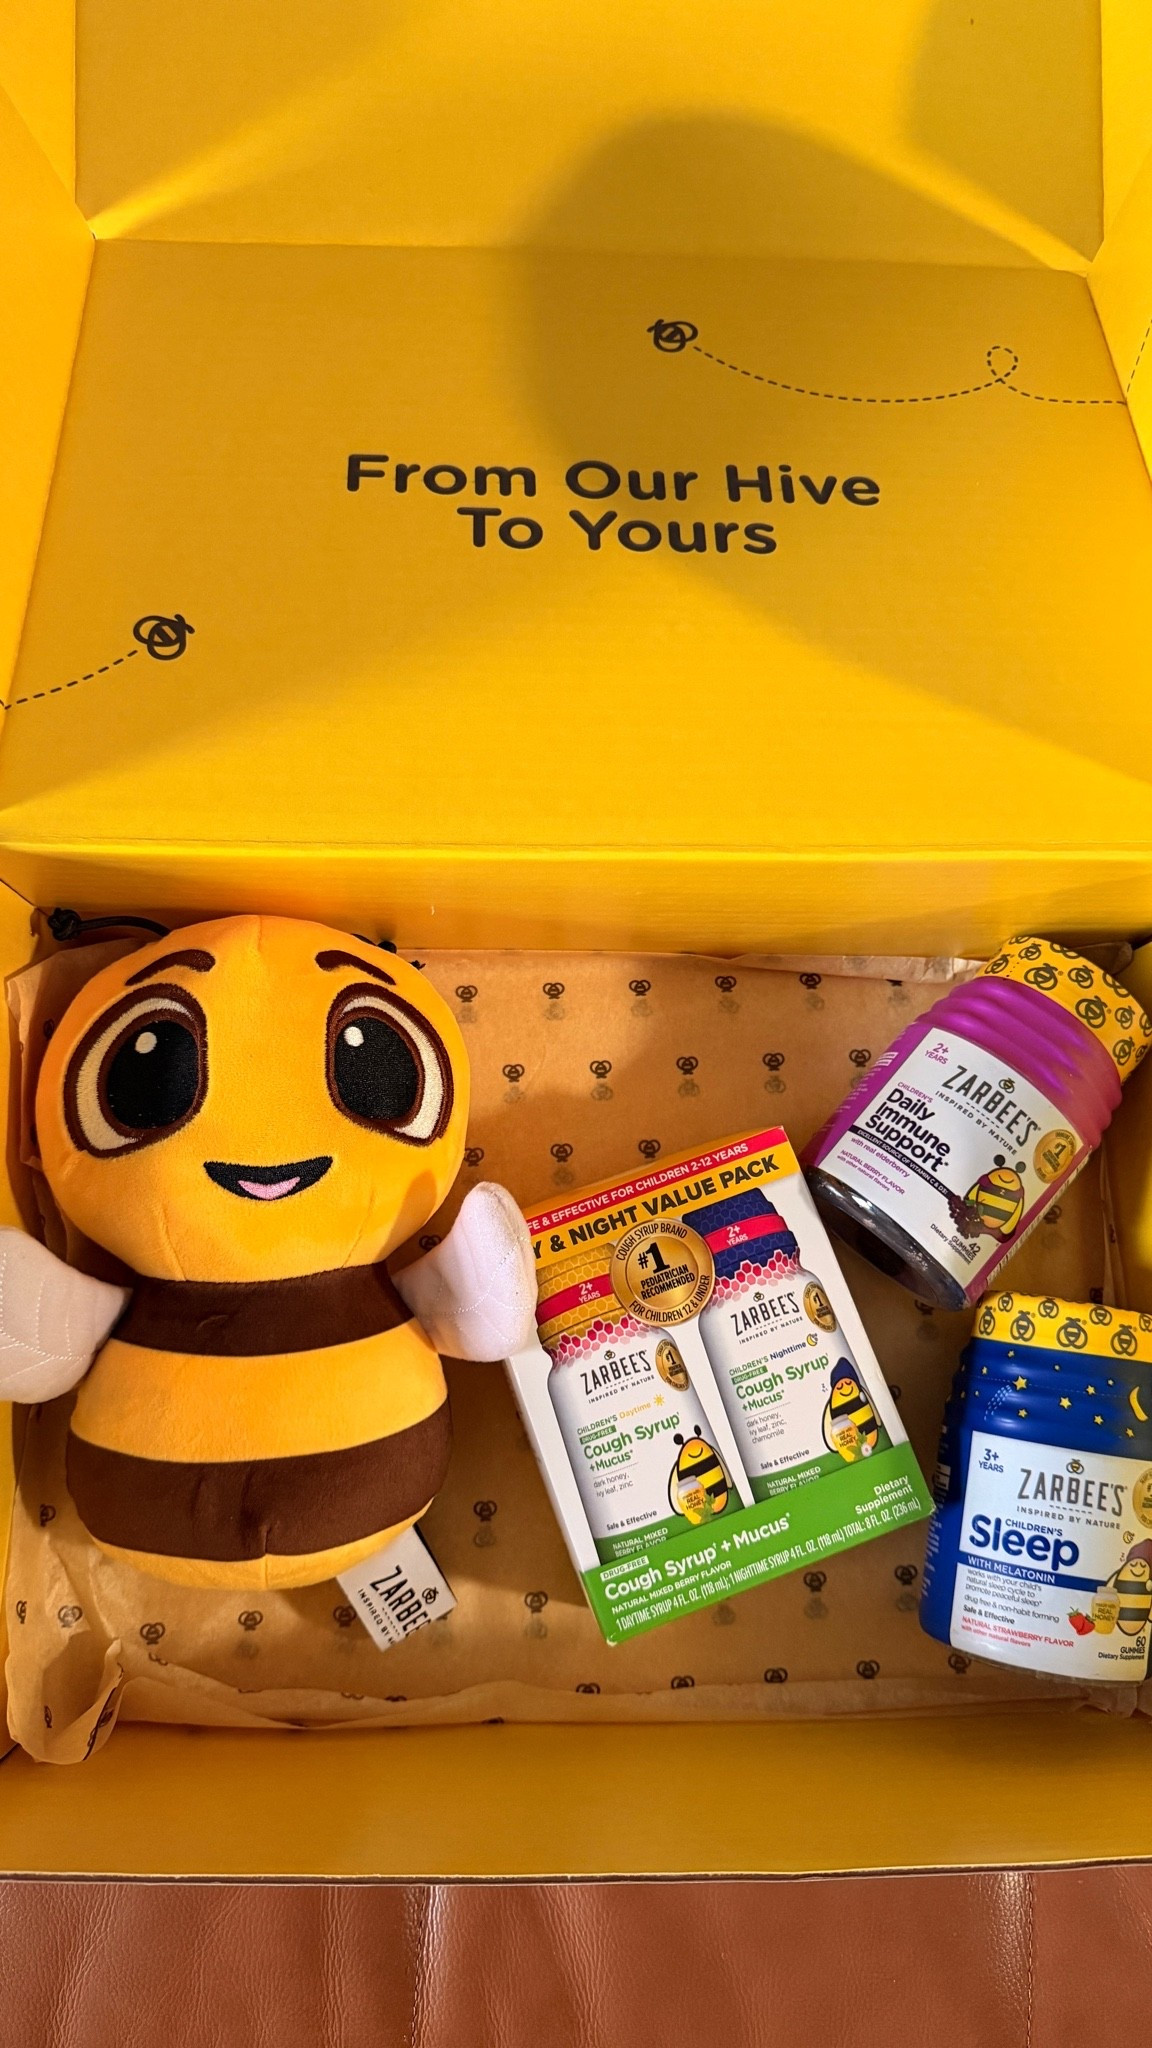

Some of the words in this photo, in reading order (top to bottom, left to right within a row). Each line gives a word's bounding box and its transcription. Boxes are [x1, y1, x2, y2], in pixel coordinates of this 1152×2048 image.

[346, 453, 537, 497] From
[565, 459, 698, 501] Our
[725, 464, 880, 506] Hive
[456, 506, 543, 549] To
[569, 509, 777, 554] Yours
[925, 1050, 948, 1065] YEARS
[932, 1042, 949, 1055] 2+
[886, 1087, 935, 1121] Daily
[897, 1081, 933, 1104] CHILDREN'S
[875, 1102, 950, 1156] Immune
[935, 1090, 974, 1119] INSPIRED
[976, 1119, 988, 1130] BY
[989, 1129, 1018, 1156] NATURE
[851, 1138, 864, 1147] with
[863, 1144, 877, 1154] real
[875, 1152, 910, 1177] elderberry
[857, 1127, 883, 1148] EXCELLENT
[882, 1143, 902, 1159] SOURCE
[908, 1162, 931, 1180] VITAMIN
[840, 1149, 862, 1165] NATURAL
[863, 1163, 882, 1177] BERRY
[881, 1175, 905, 1194] FLAVOR
[525, 1220, 540, 1233] FE
[542, 1216, 550, 1226] &
[551, 1194, 609, 1222] EFFECTIVE
[610, 1185, 634, 1200] FOR
[636, 1165, 689, 1190] CHILDREN
[691, 1156, 712, 1171] 2-12
[712, 1143, 748, 1161] YEARS
[550, 1235, 566, 1252] &
[569, 1206, 637, 1244] NIGHT
[642, 1177, 716, 1215] VALUE
[719, 1155, 778, 1188] PACK
[616, 1235, 637, 1261] COUGH
[634, 1223, 658, 1239] SYRUP
[660, 1223, 687, 1239] BRAND
[727, 1225, 741, 1238] 2+
[727, 1233, 748, 1246] YEARS
[930, 1223, 948, 1244] Dietary
[637, 1242, 670, 1274] #1
[969, 1242, 981, 1256] 42
[578, 1282, 592, 1295] 2+
[641, 1264, 689, 1289] PEDIATRICIAN
[641, 1272, 695, 1300] RECOMMENDED
[578, 1291, 600, 1304] YEARS
[629, 1300, 646, 1317] FOR
[645, 1309, 683, 1323] CHILDREN
[682, 1304, 693, 1315] 12
[690, 1300, 698, 1308] &
[696, 1275, 710, 1302] UNDER
[731, 1292, 800, 1336] ZARBEE'S
[739, 1330, 768, 1344] INSPIRED
[780, 1316, 803, 1327] NATURE
[729, 1356, 768, 1376] CHILDREN'S
[770, 1342, 806, 1360] Nighttime
[581, 1351, 651, 1395] ZARBEE'S
[736, 1373, 783, 1399] Cough
[588, 1389, 618, 1403] INSPIRED
[631, 1374, 654, 1386] NATURE
[577, 1414, 617, 1435] CHILDREN'S
[619, 1402, 651, 1419] Daytime
[583, 1432, 632, 1459] Cough
[751, 1429, 784, 1444] chamomile
[760, 1461, 773, 1470] Safe
[779, 1449, 809, 1464] Effective
[978, 1460, 1004, 1473] YEARS
[983, 1448, 999, 1462] 3+
[619, 1480, 633, 1491] zinc
[767, 1475, 797, 1491] NATURAL
[797, 1466, 821, 1480] MIXED
[873, 1476, 908, 1496] Dietary
[855, 1485, 912, 1515] Supplement
[606, 1522, 619, 1531] Safe
[626, 1511, 657, 1525] Effective
[1005, 1518, 1063, 1537] CHILDREN'S
[1016, 1505, 1064, 1521] INSPIRED
[1069, 1515, 1082, 1524] BY
[1086, 1517, 1121, 1530] NATURE
[613, 1537, 643, 1553] NATURAL
[643, 1527, 668, 1541] MIXED
[969, 1514, 1080, 1571] Sleep
[603, 1557, 646, 1579] DRUG-FREE
[605, 1568, 662, 1599] Cough
[721, 1540, 731, 1551] +
[616, 1618, 622, 1631] 1
[620, 1607, 651, 1629] DAYTIME
[650, 1599, 672, 1618] SYRUP
[672, 1596, 679, 1608] 4
[677, 1593, 690, 1606] FL.
[688, 1587, 701, 1602] OZ.
[700, 1581, 715, 1599] (118
[714, 1576, 731, 1591] mL);
[729, 1573, 735, 1584] 1
[733, 1559, 769, 1582] NIGHTTIME
[768, 1550, 789, 1568] SYRUP
[790, 1547, 796, 1559] 4
[794, 1544, 807, 1557] FL.
[805, 1539, 818, 1553] OZ.
[817, 1533, 832, 1551] (118
[831, 1528, 845, 1543] mL)
[843, 1521, 866, 1538] TOTAL:
[864, 1517, 872, 1529] 8
[869, 1514, 882, 1527] FL.
[880, 1508, 893, 1522] OZ.
[891, 1501, 908, 1520] (236
[907, 1496, 921, 1511] mL)
[967, 1555, 992, 1571] WITH
[993, 1561, 1056, 1584] MELATONIN
[611, 1595, 648, 1614] NATURAL
[649, 1584, 674, 1599] MIXED
[674, 1573, 699, 1589] BERRY
[700, 1560, 732, 1578] FLAVOR
[965, 1583, 991, 1595] promote
[992, 1591, 1020, 1603] peaceful
[966, 1576, 987, 1586] natural
[988, 1582, 1006, 1592] sleep
[1007, 1587, 1026, 1596] cycle
[1027, 1590, 1035, 1598] to
[967, 1569, 985, 1578] works
[986, 1574, 1001, 1582] with
[1002, 1578, 1018, 1586] your
[1019, 1581, 1042, 1592] child's
[358, 1588, 384, 1625] INSPIRED
[380, 1624, 391, 1636] BY
[963, 1604, 976, 1614] Safe
[984, 1611, 1015, 1624] Effective
[964, 1594, 978, 1604] drug
[979, 1597, 991, 1606] free
[998, 1605, 1031, 1617] non-habit
[1032, 1611, 1060, 1623] forming
[961, 1616, 991, 1630] NATURAL
[993, 1626, 1043, 1641] STRAWBERRY
[1044, 1636, 1074, 1647] FLAVOR
[1135, 1636, 1146, 1647] 60
